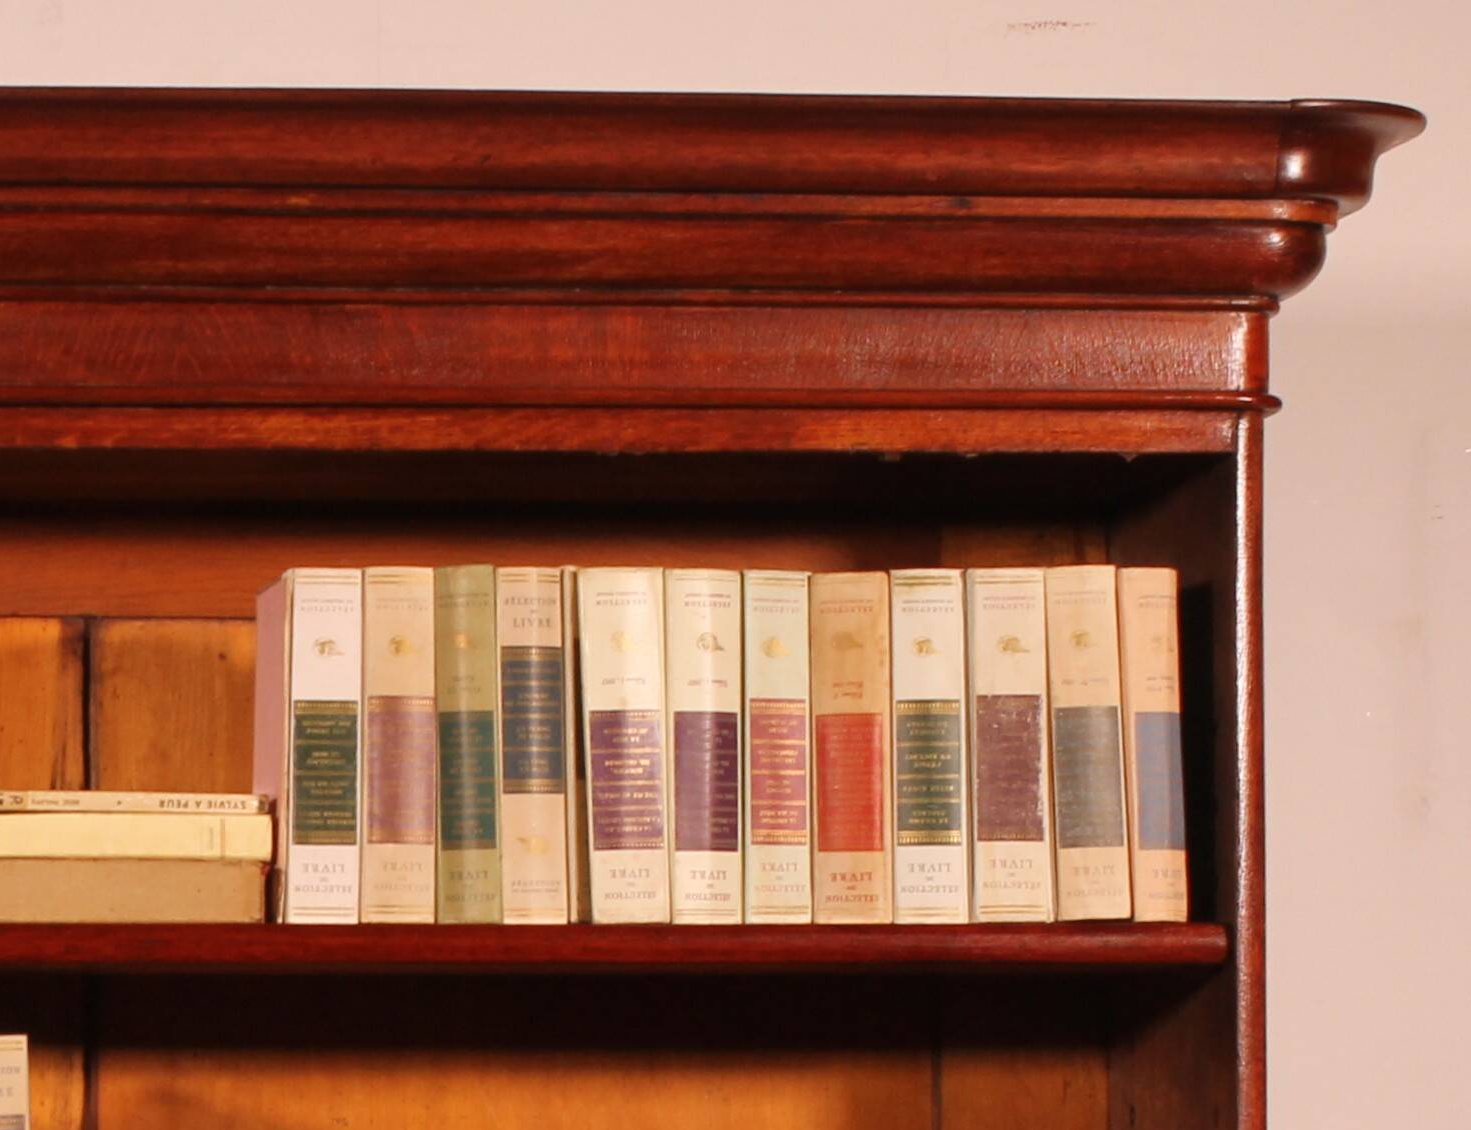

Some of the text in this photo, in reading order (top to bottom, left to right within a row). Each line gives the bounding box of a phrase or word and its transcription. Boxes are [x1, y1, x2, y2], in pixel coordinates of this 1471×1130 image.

[514, 618, 552, 627] LIVRE
[158, 800, 190, 810] PEUR
[207, 799, 247, 810] SYLVIE
[303, 864, 345, 872] LIVRE
[761, 863, 797, 872] LIVRE
[907, 863, 951, 872] LIVRE
[990, 859, 1033, 869] LIVRE
[609, 869, 649, 879] LIVRE
[689, 870, 727, 880] LIVRE
[830, 872, 872, 882] LIVRE
